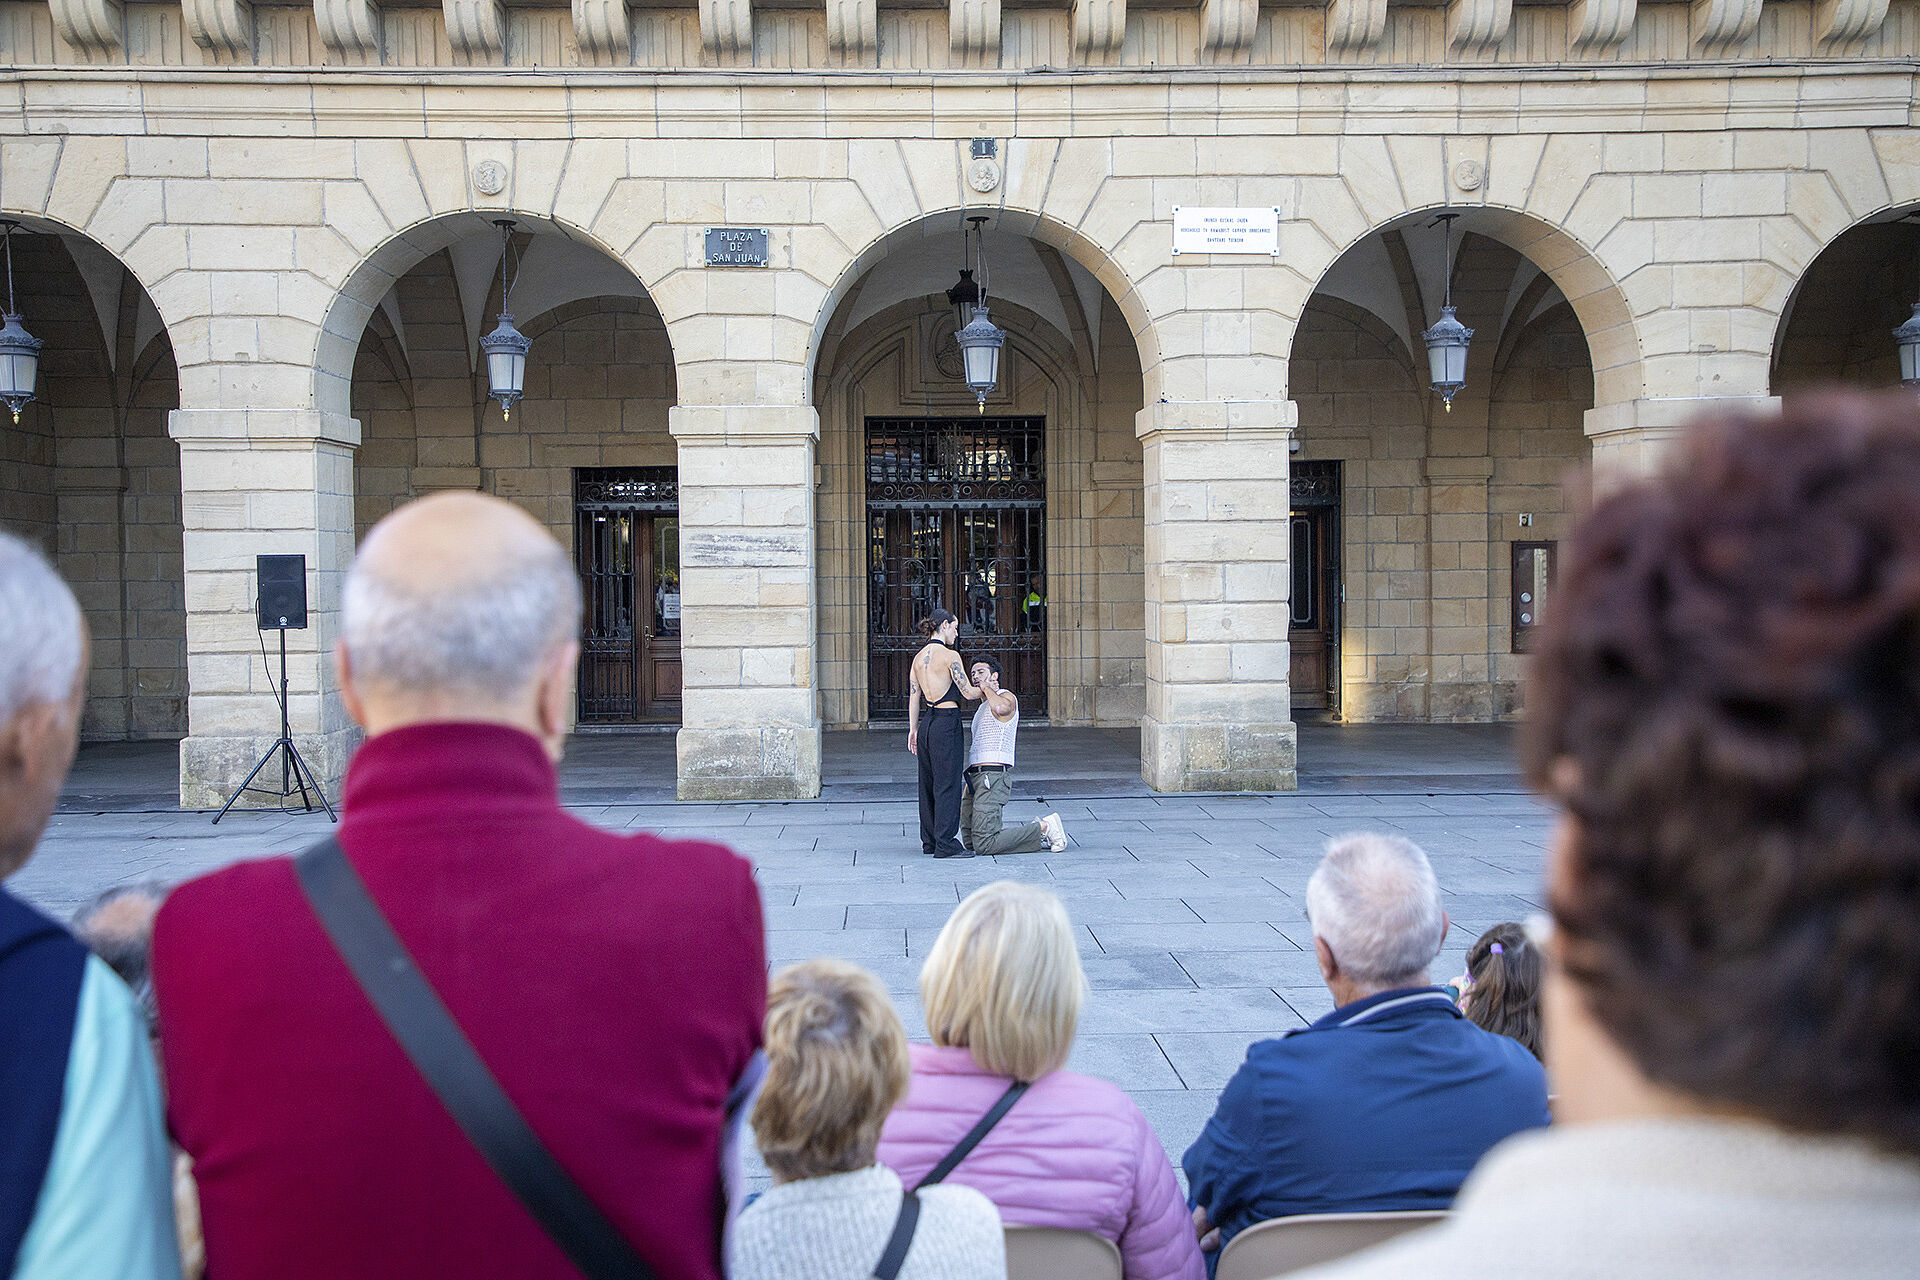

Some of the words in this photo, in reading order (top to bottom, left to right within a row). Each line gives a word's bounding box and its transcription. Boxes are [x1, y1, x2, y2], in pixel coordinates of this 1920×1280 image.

[720, 231, 753, 241] PLAZA
[730, 242, 743, 252] DE
[712, 253, 731, 262] SAN
[734, 253, 760, 263] JUAN
